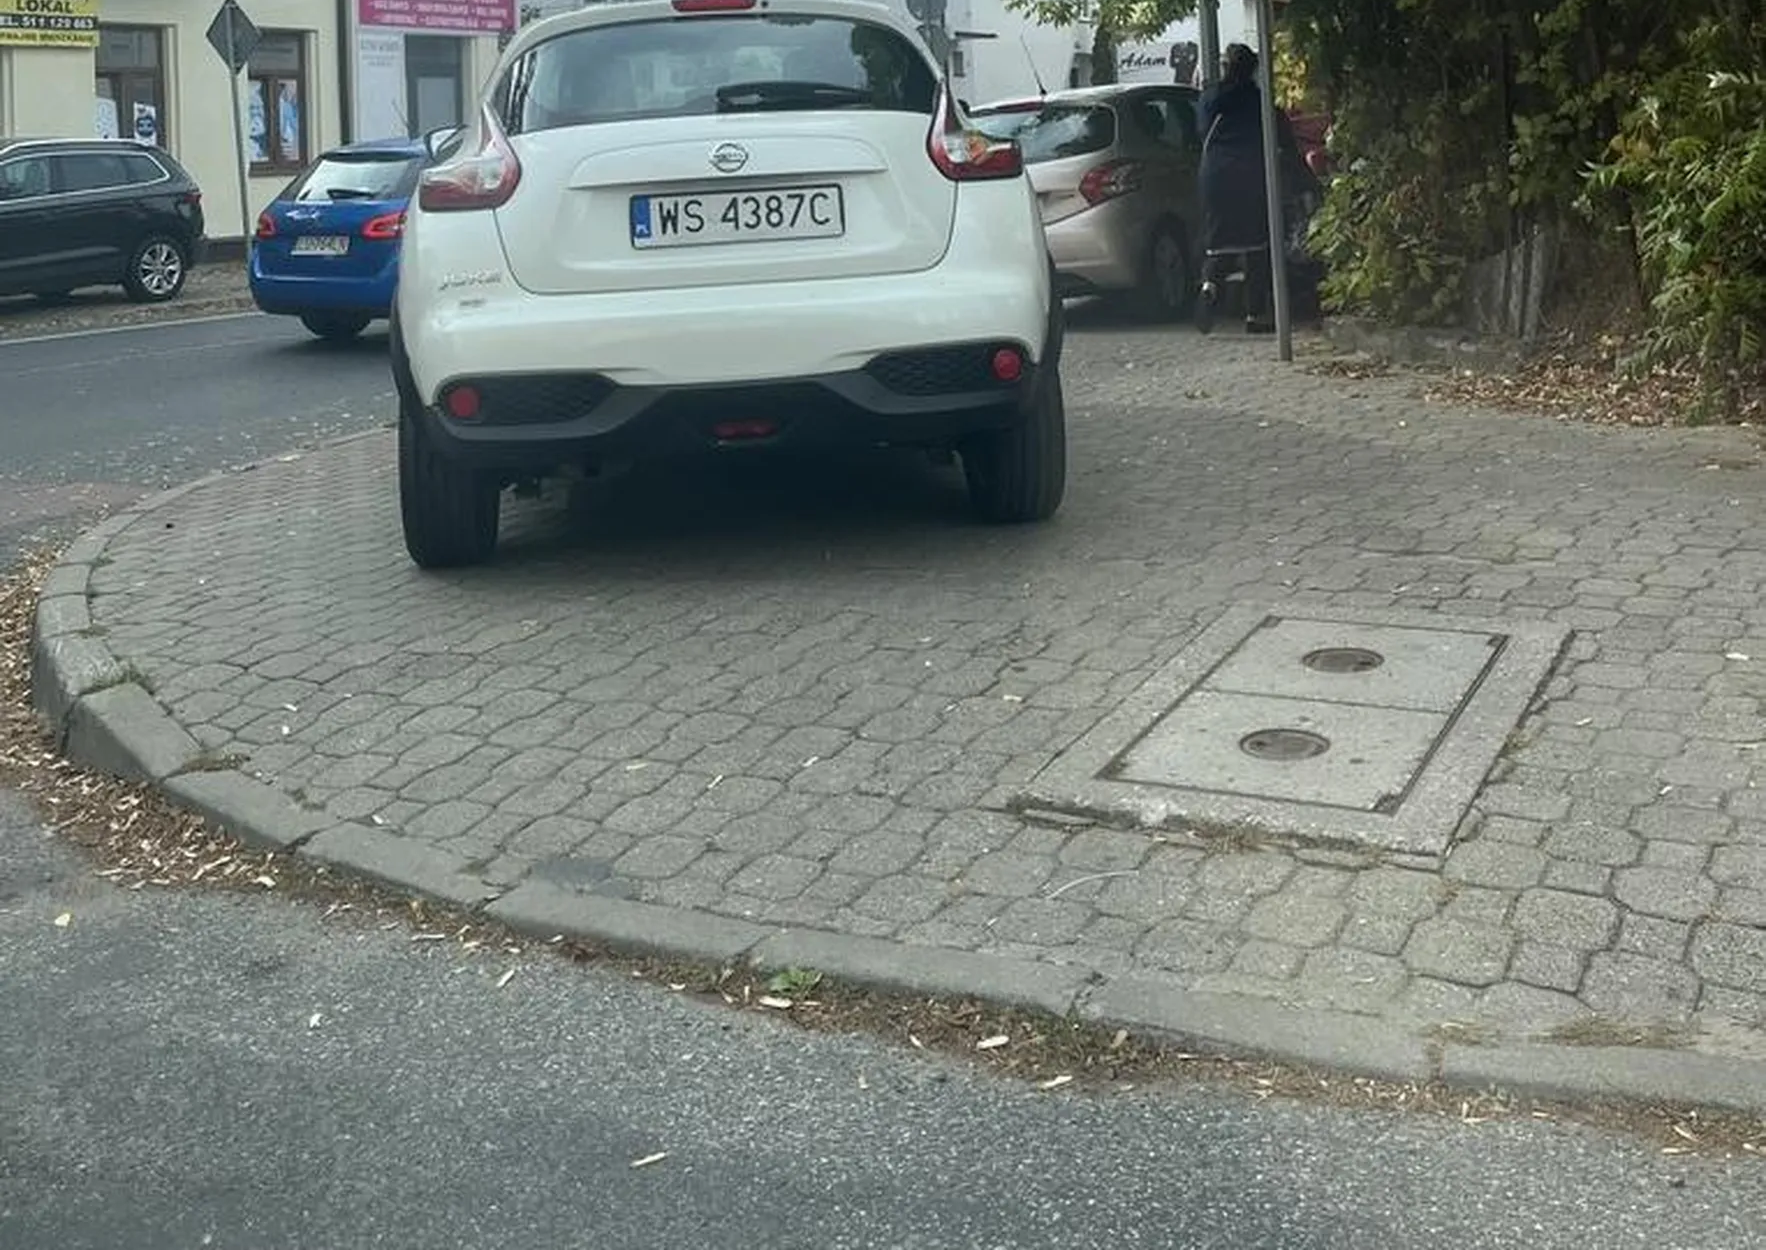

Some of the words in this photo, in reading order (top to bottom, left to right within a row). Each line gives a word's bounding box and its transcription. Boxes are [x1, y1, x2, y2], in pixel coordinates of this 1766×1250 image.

[22, 16, 46, 27] 511
[1121, 52, 1166, 67] Adam
[659, 200, 705, 235] WS
[721, 192, 831, 231] 4387C
